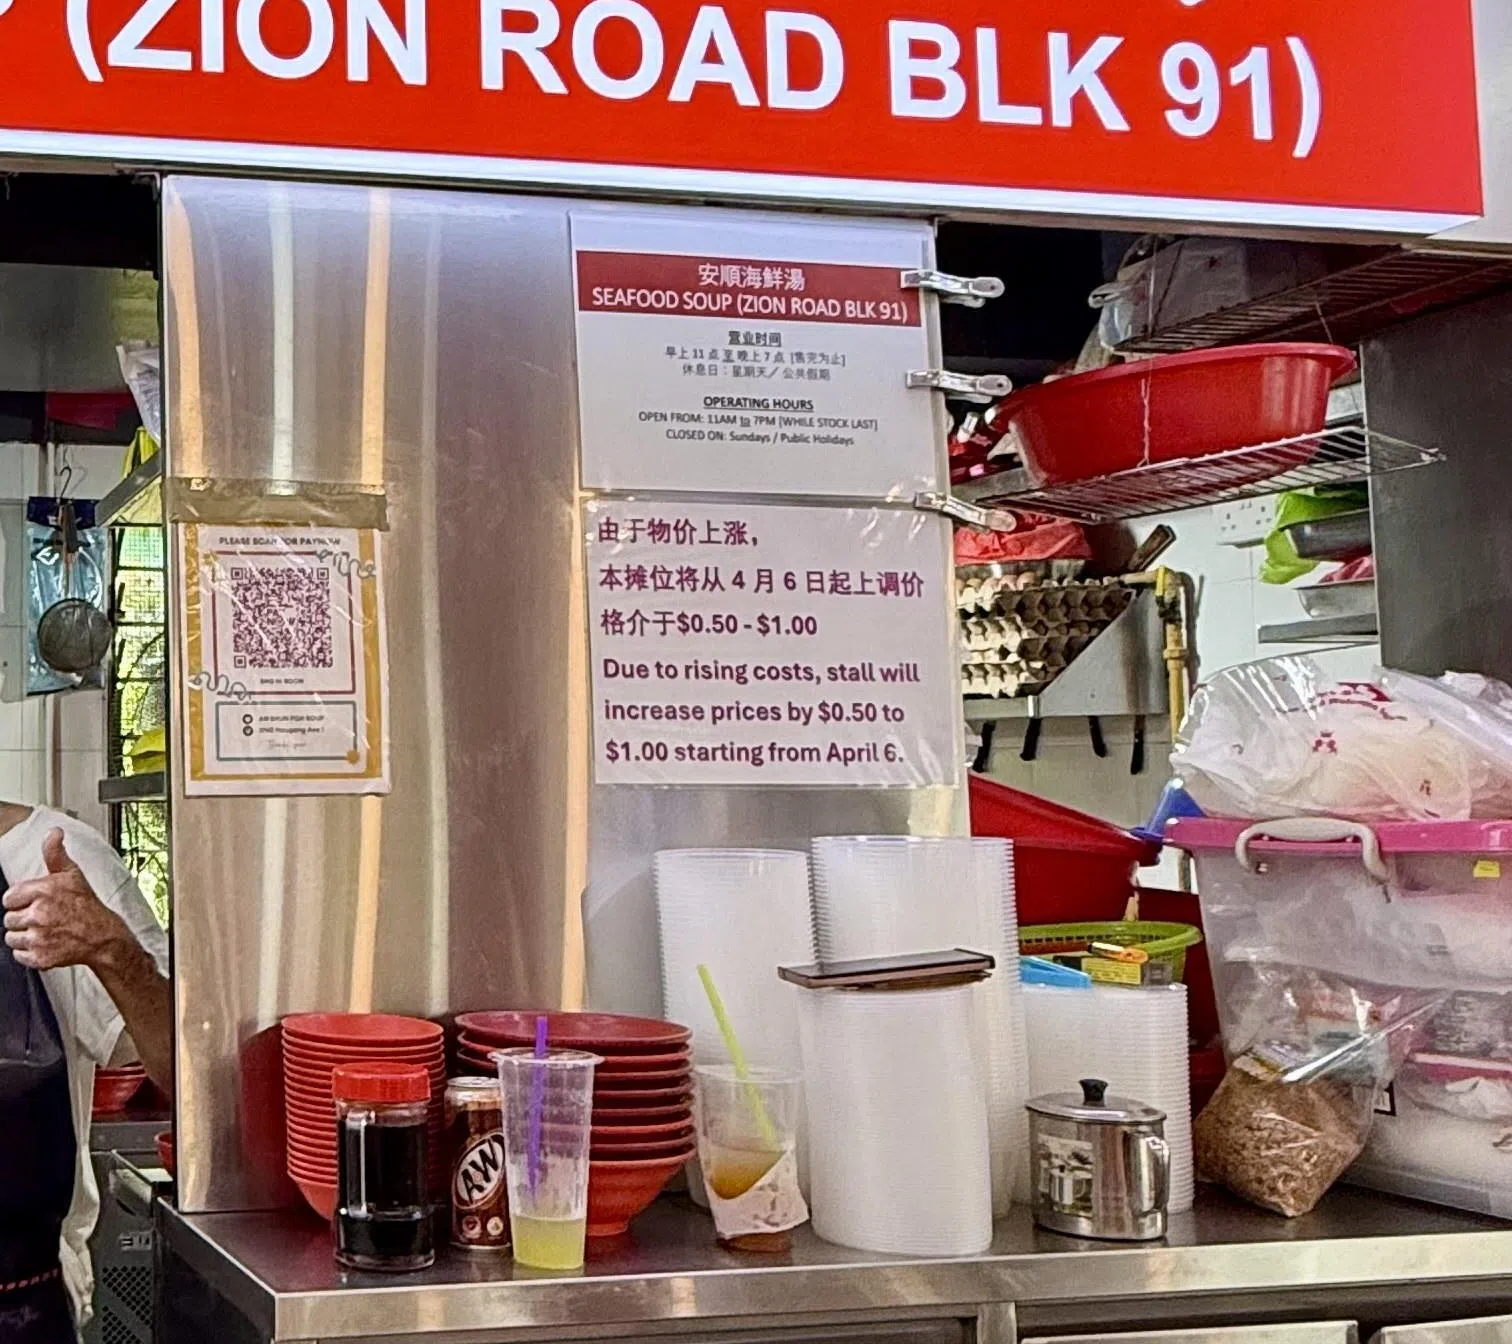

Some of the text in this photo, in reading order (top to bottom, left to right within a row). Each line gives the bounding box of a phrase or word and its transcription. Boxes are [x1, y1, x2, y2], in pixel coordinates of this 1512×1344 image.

[889, 18, 1129, 132] BLK
[1161, 35, 1323, 159] 91)
[698, 262, 806, 292] 安順海鮮湯
[592, 287, 908, 323] SEAFOOD SOUP (ZION ROAD BLK 91)
[703, 396, 814, 411] OPERATING HOURS
[638, 411, 668, 422] OPEN
[670, 412, 704, 424] FROM:
[707, 414, 737, 425] 11AM
[754, 416, 776, 426] 7PM
[817, 418, 849, 429] STOCK
[851, 419, 878, 432] LAST]
[665, 429, 705, 441] CLOSED
[729, 431, 770, 444] Sundays
[780, 433, 810, 445] Public
[813, 434, 854, 447] Holidays
[756, 613, 818, 637] $1.00
[602, 657, 921, 685] Due to rising costs, stall will
[603, 699, 905, 726] increase prices by $0.50 to
[605, 740, 905, 767] $1.00 starting from April 6.
